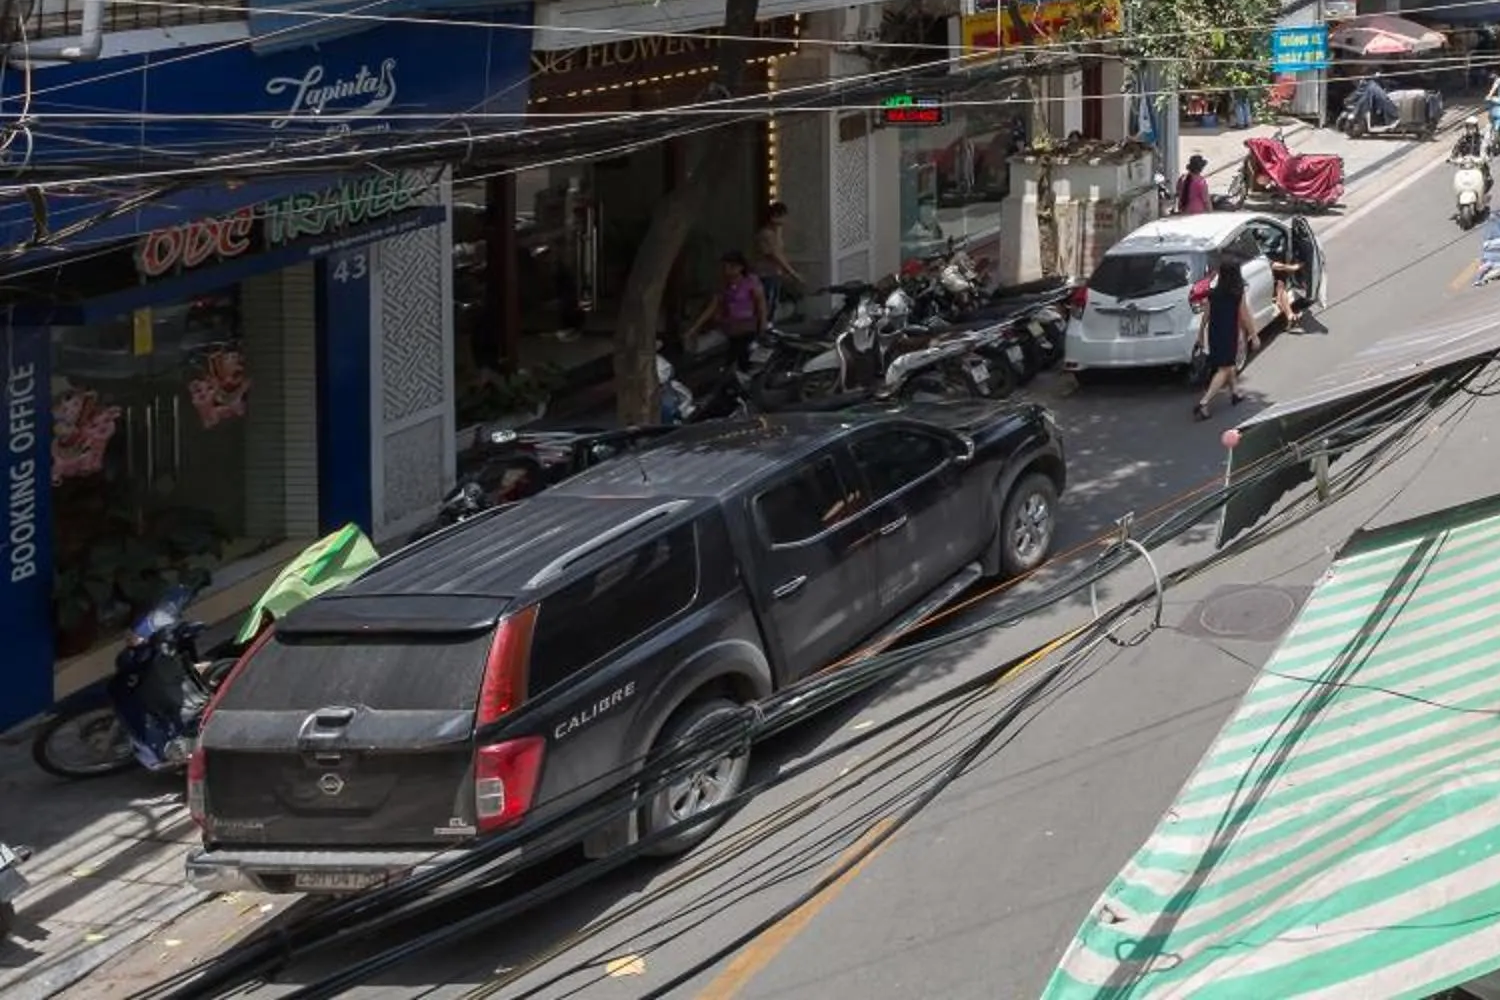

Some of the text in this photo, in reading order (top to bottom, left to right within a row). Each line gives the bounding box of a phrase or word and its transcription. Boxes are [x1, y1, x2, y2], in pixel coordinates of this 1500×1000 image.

[585, 33, 696, 70] FLOWER
[143, 204, 252, 275] ODC
[265, 174, 414, 242] TRAVEL
[333, 254, 367, 283] 43
[9, 362, 36, 582] BOOKING OFFICE
[555, 681, 636, 739] CALIBRE
